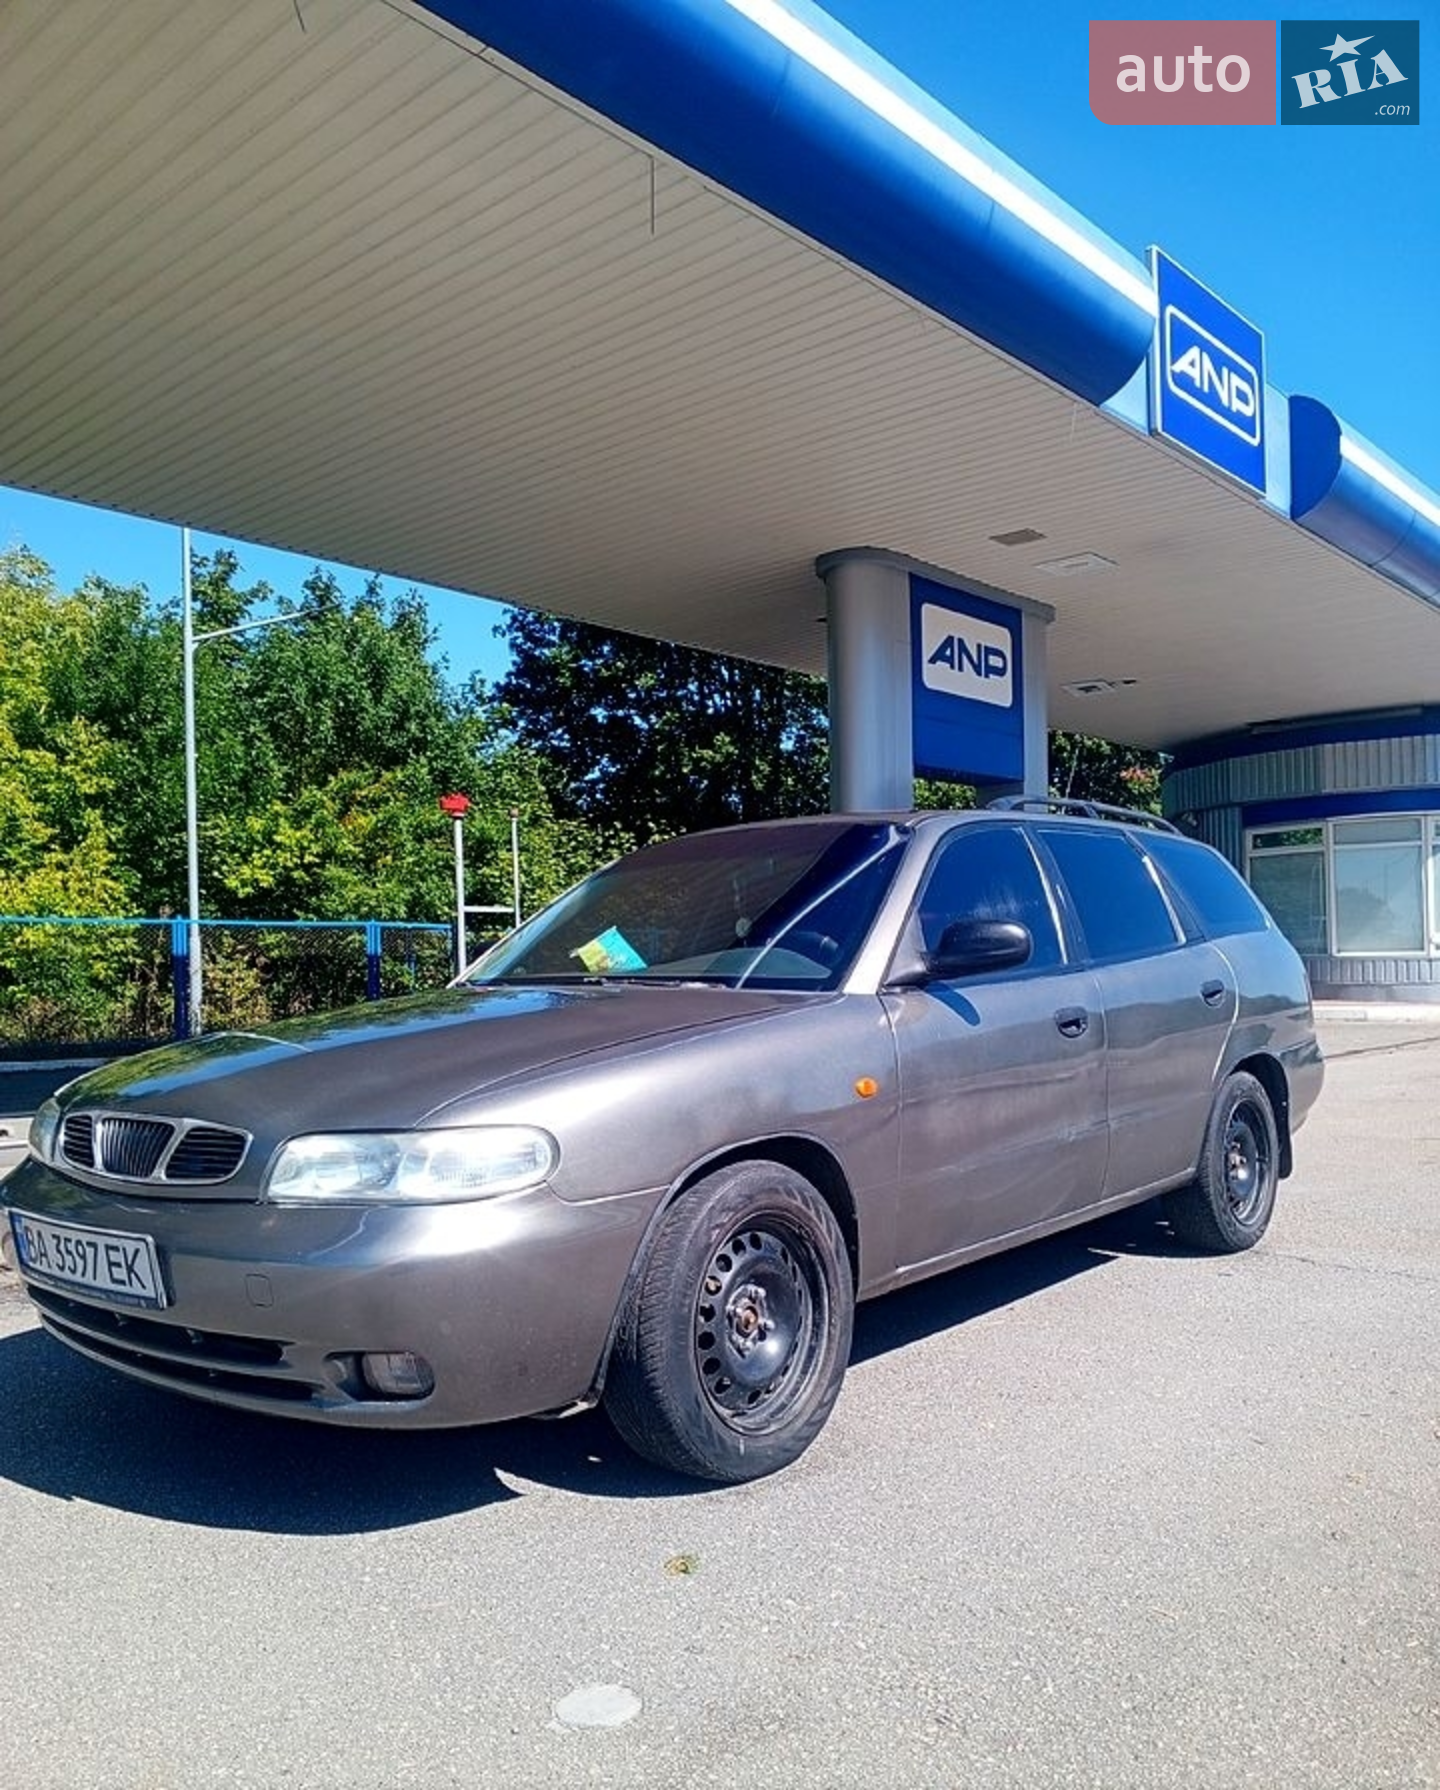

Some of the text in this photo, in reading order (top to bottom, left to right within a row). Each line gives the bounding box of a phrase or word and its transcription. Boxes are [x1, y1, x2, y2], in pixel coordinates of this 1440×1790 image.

[1170, 345, 1256, 417] ANP
[927, 634, 1008, 679] ANP
[24, 1226, 51, 1268] BA
[51, 1233, 99, 1281] 3597
[104, 1243, 147, 1290] EK
